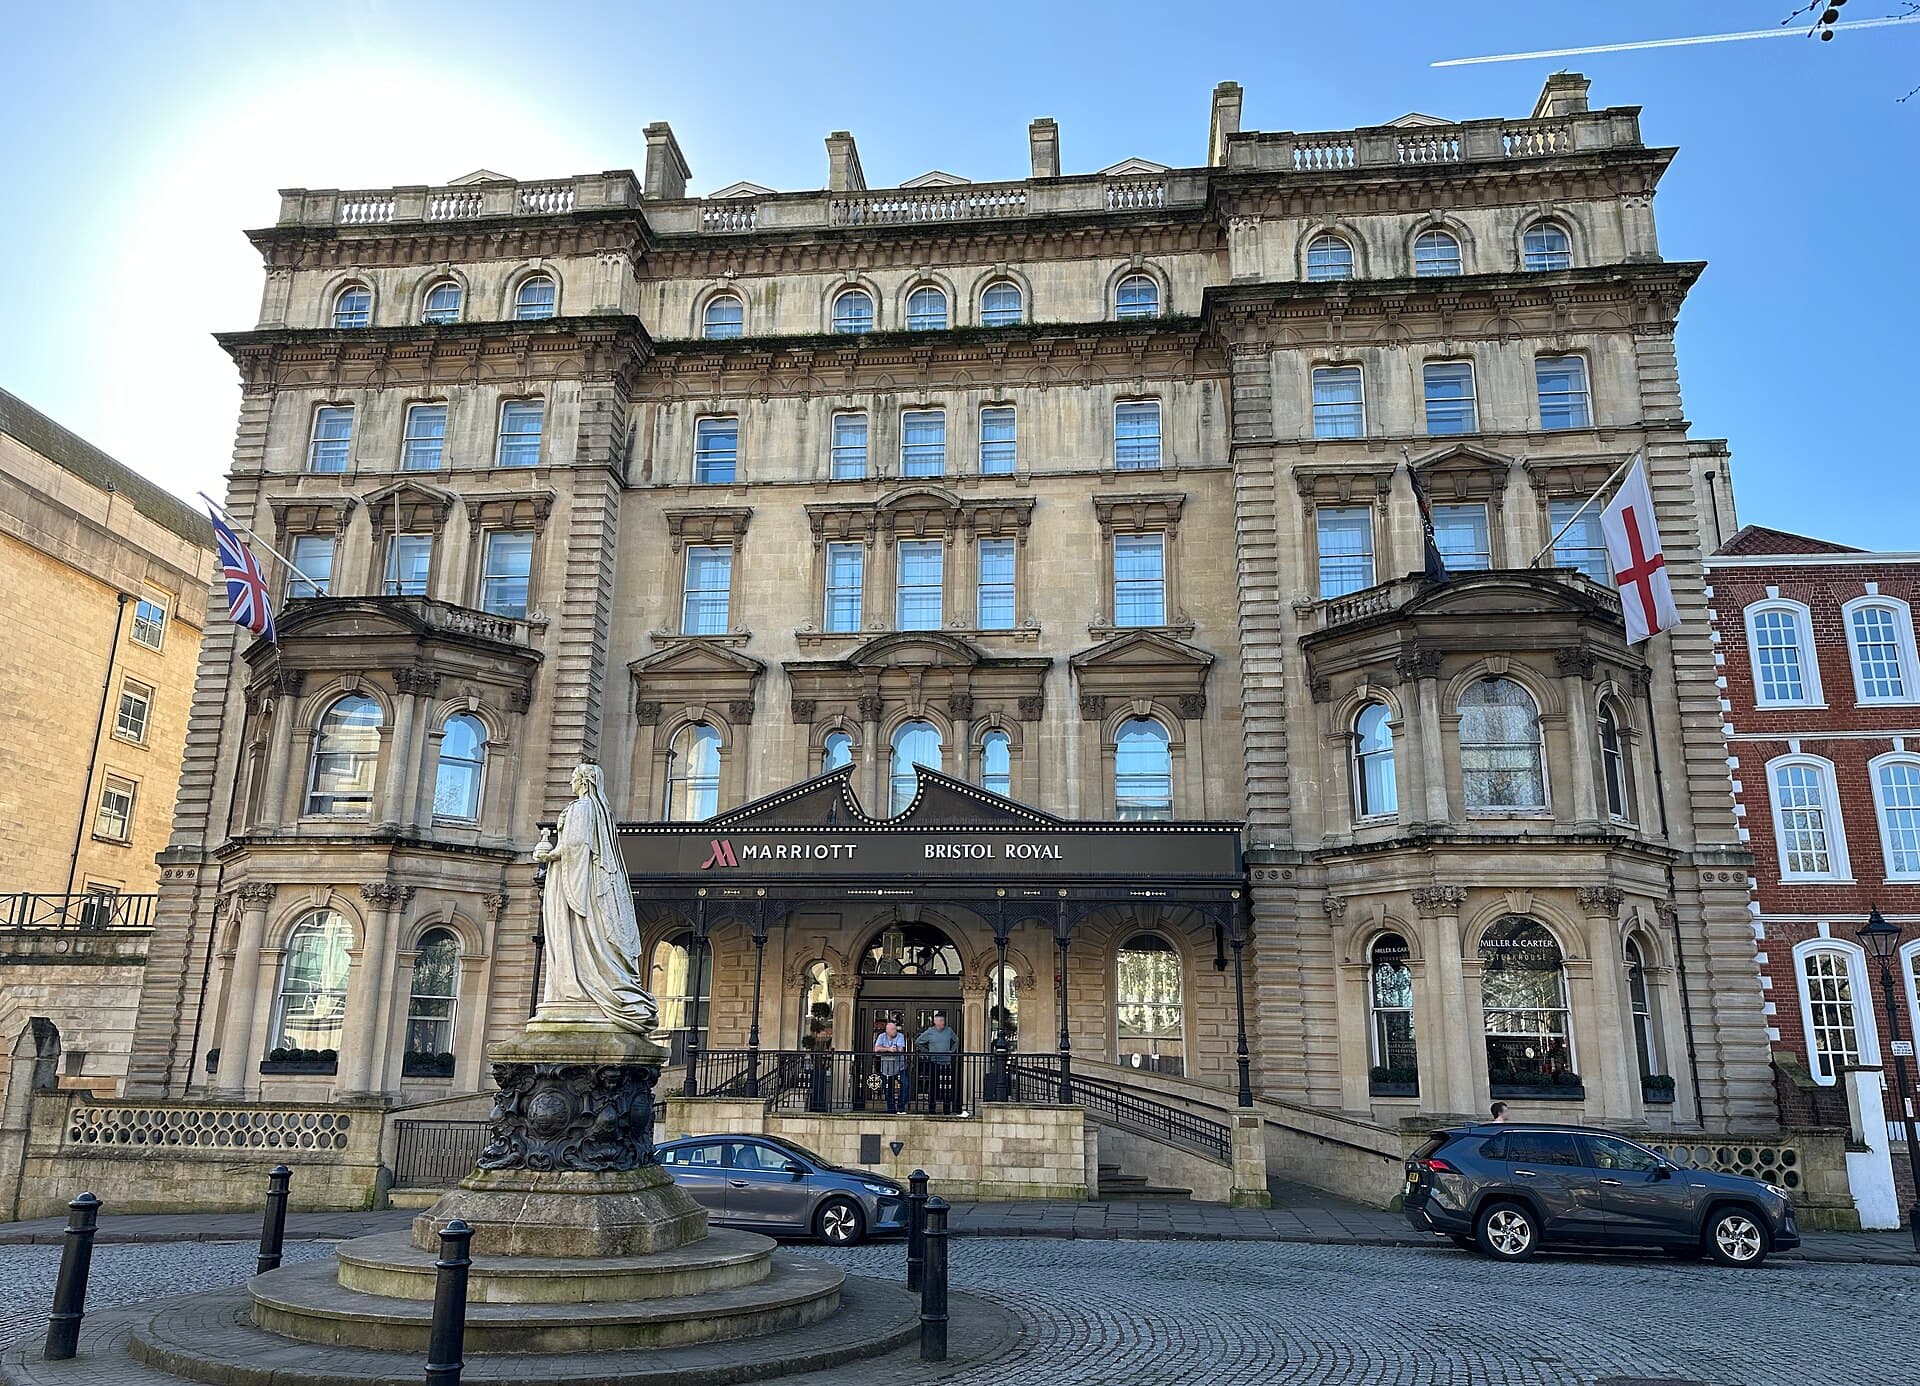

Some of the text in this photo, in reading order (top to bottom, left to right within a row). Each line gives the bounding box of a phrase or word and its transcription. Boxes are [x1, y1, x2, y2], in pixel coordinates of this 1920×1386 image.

[742, 844, 857, 859] MARRIOTT
[924, 844, 1063, 859] BRISTOL ROYAL
[1480, 939, 1511, 947] MILLER
[1520, 939, 1554, 948] CARTER
